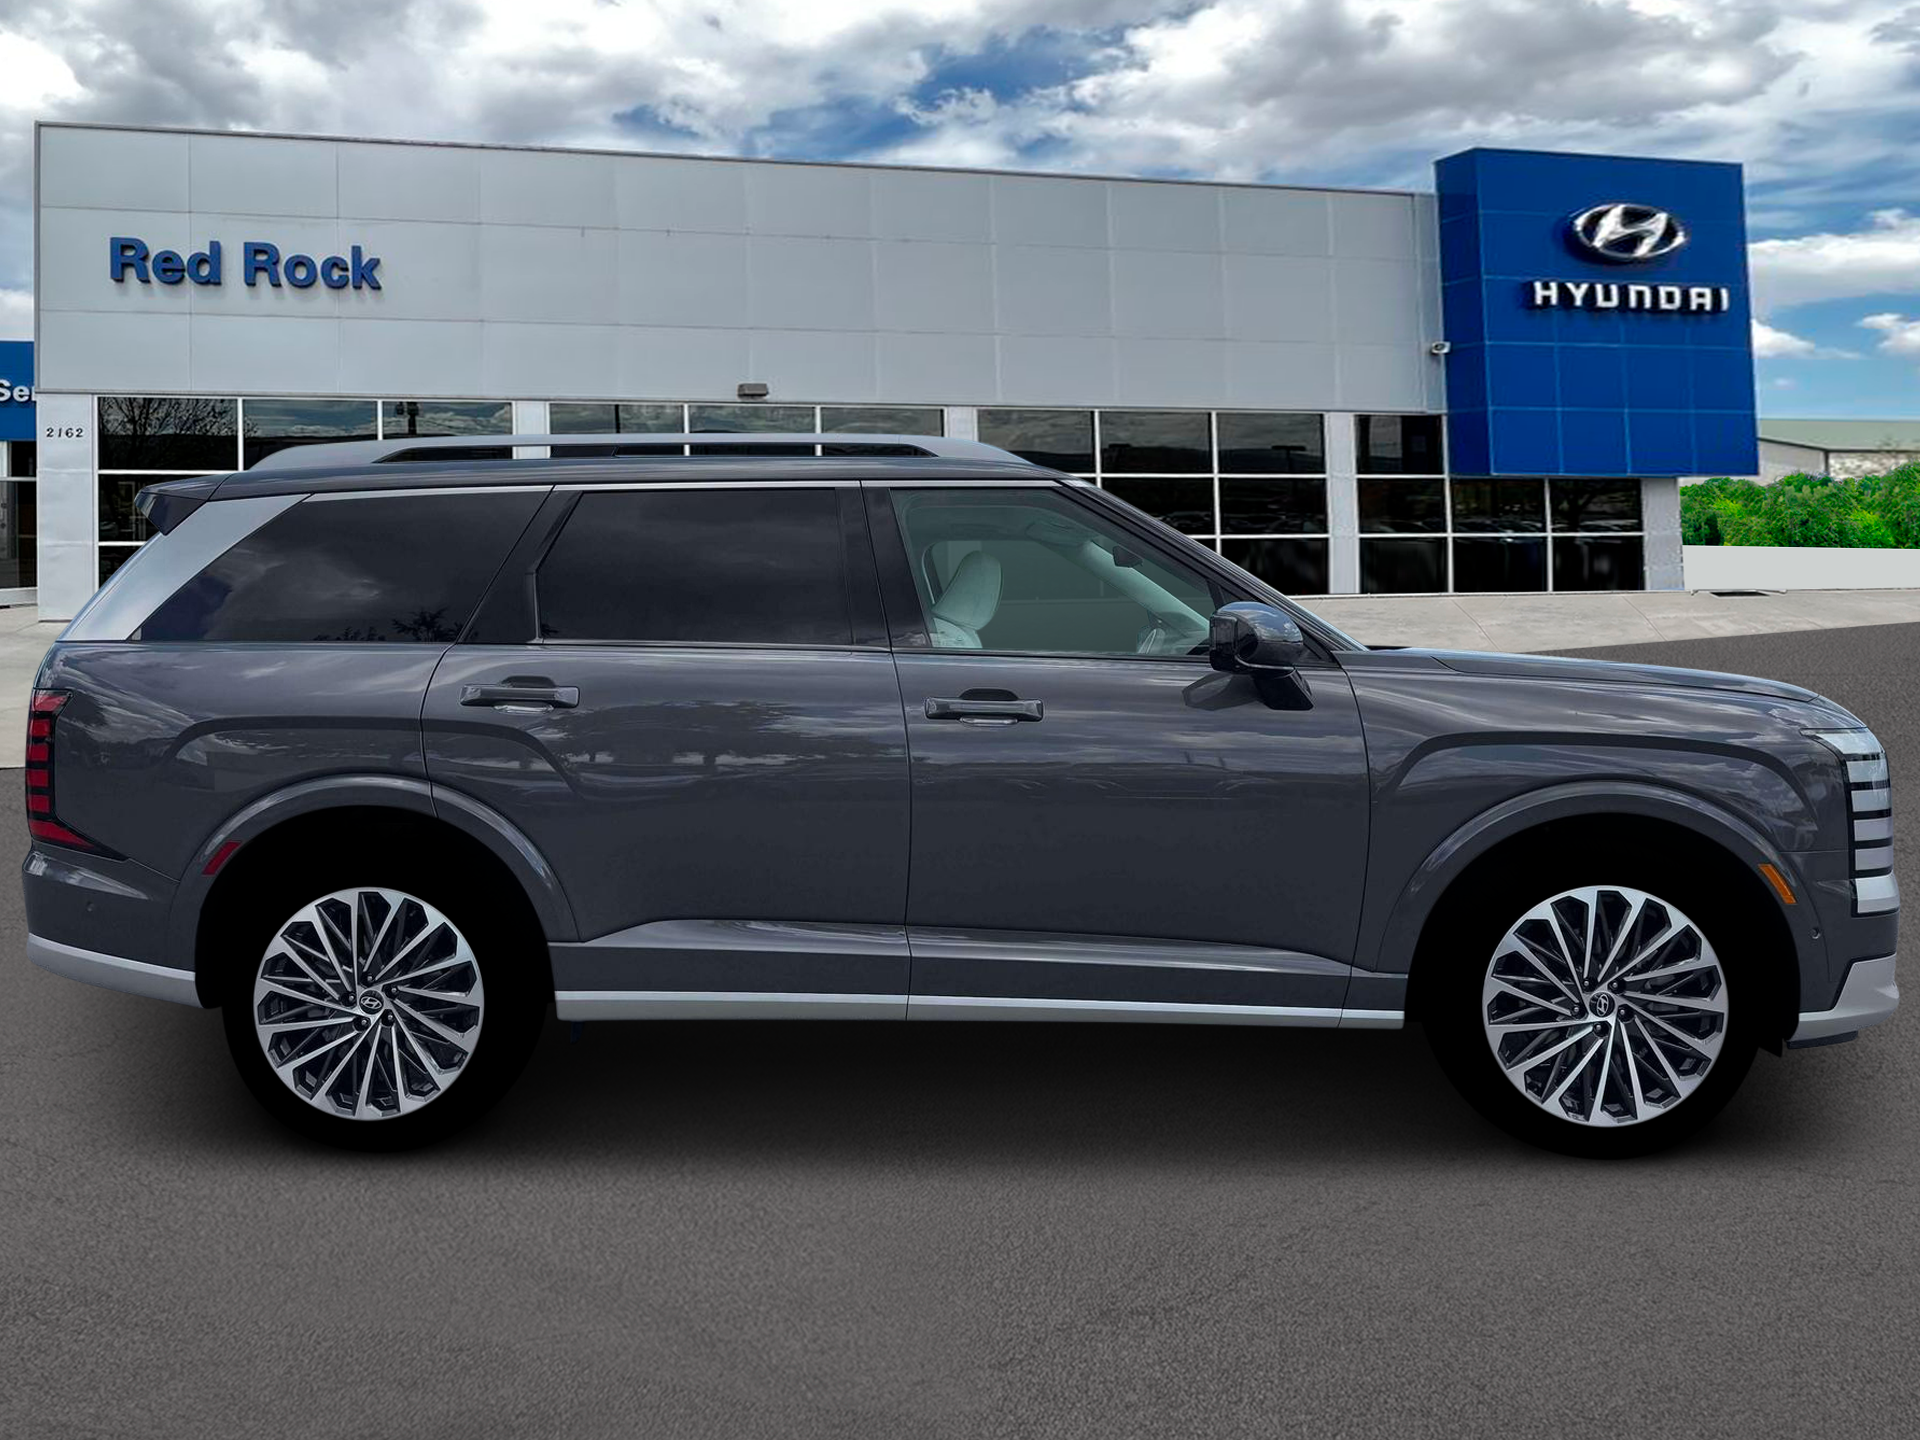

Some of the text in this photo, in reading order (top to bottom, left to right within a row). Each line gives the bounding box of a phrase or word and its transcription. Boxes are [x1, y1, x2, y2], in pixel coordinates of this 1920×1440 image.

[110, 237, 381, 290] Red Rock
[1534, 280, 1729, 312] HYUNDAI
[46, 427, 83, 438] 2162
